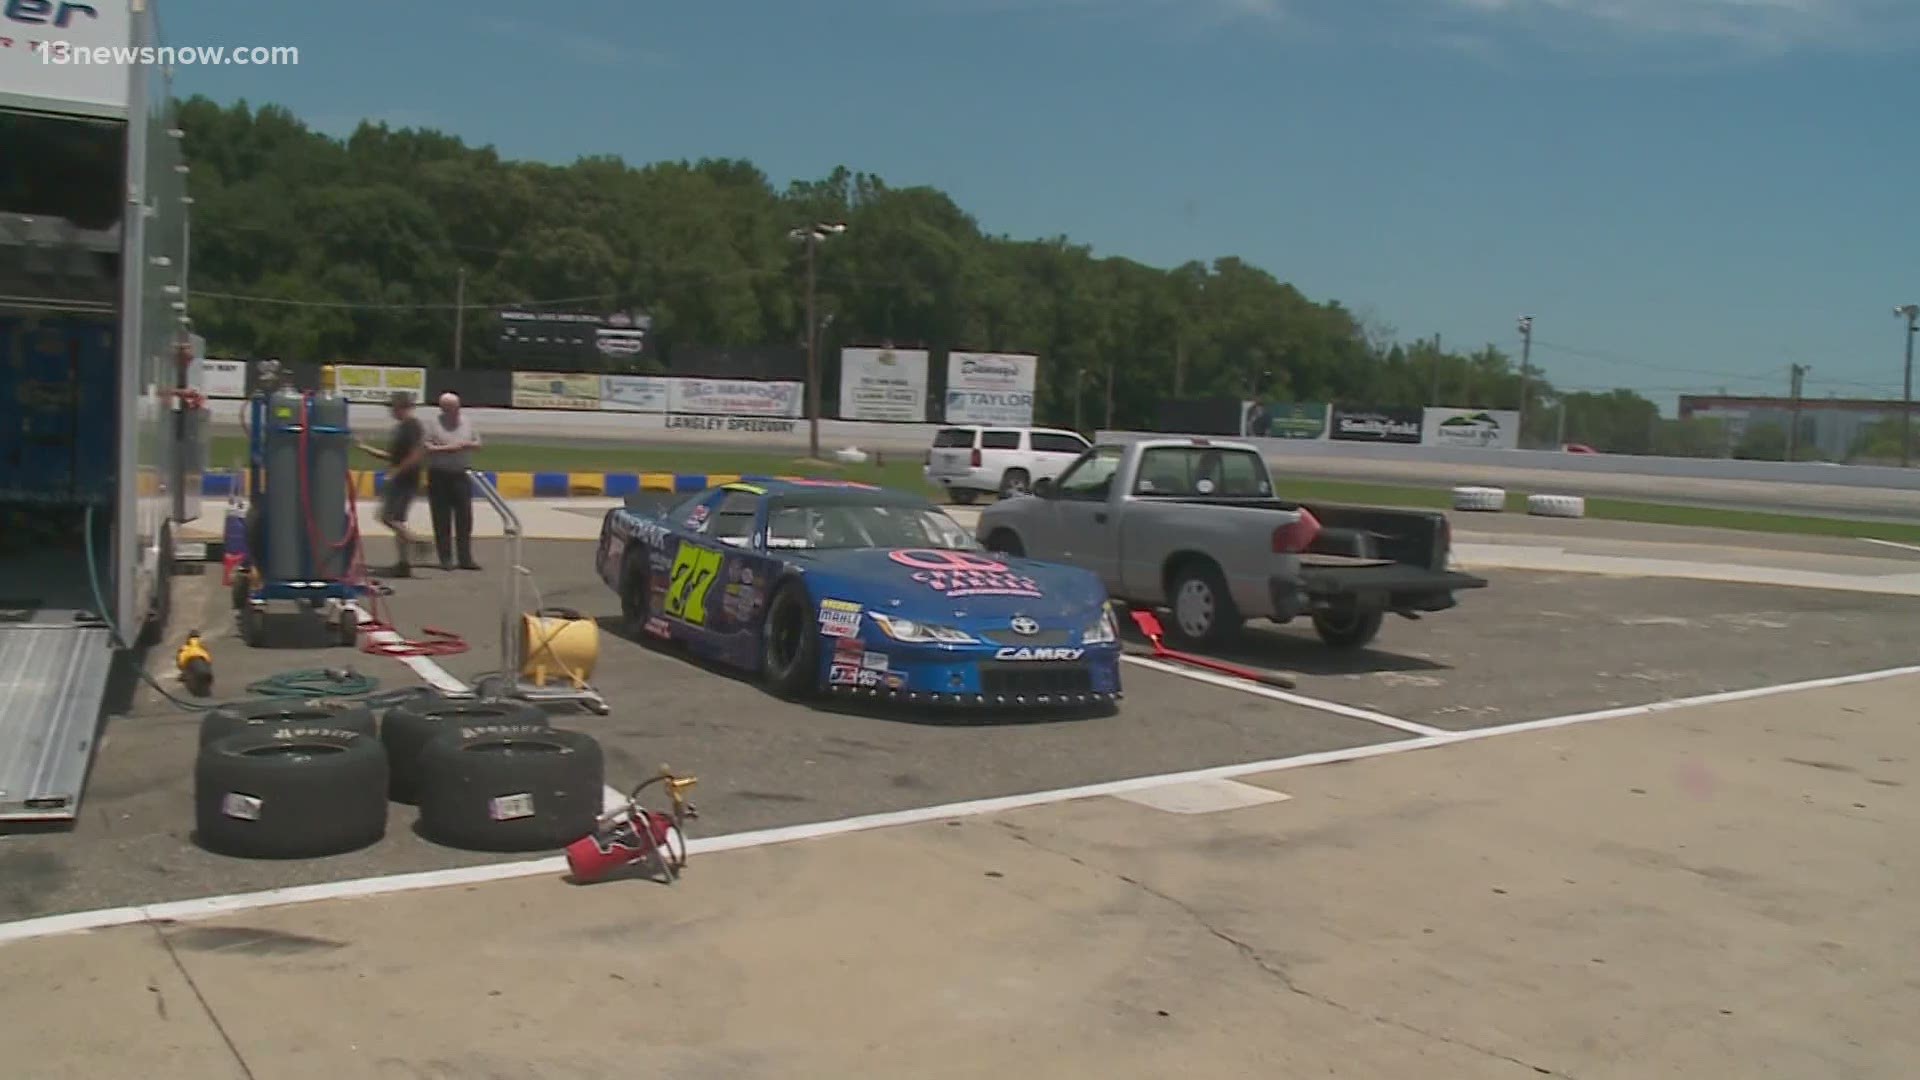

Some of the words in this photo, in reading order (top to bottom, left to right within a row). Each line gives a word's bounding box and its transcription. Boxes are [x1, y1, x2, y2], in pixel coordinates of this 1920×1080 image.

[969, 393, 1032, 407] TAYLOR
[664, 415, 723, 430] LANGLEY
[727, 416, 796, 433] SPEEDWAY
[994, 647, 1086, 661] CAMRY
